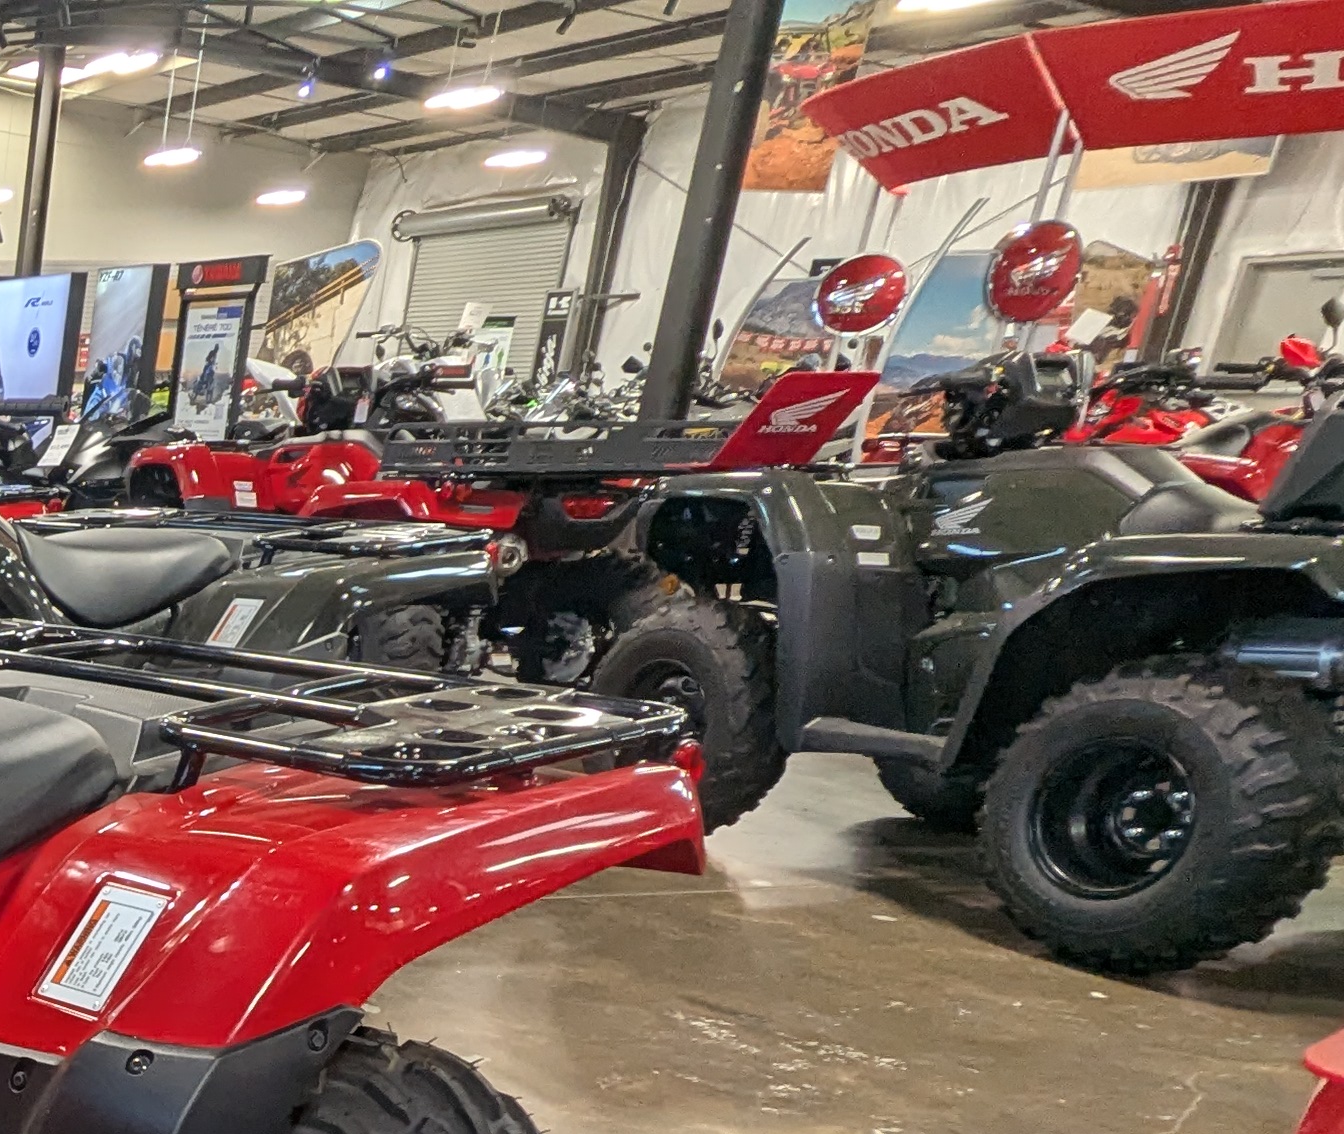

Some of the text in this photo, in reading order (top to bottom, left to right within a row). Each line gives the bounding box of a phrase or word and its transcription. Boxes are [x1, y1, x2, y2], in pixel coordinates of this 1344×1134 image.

[837, 96, 1009, 159] HONDA
[758, 424, 818, 433] HONDA
[930, 527, 981, 537] HONDA
